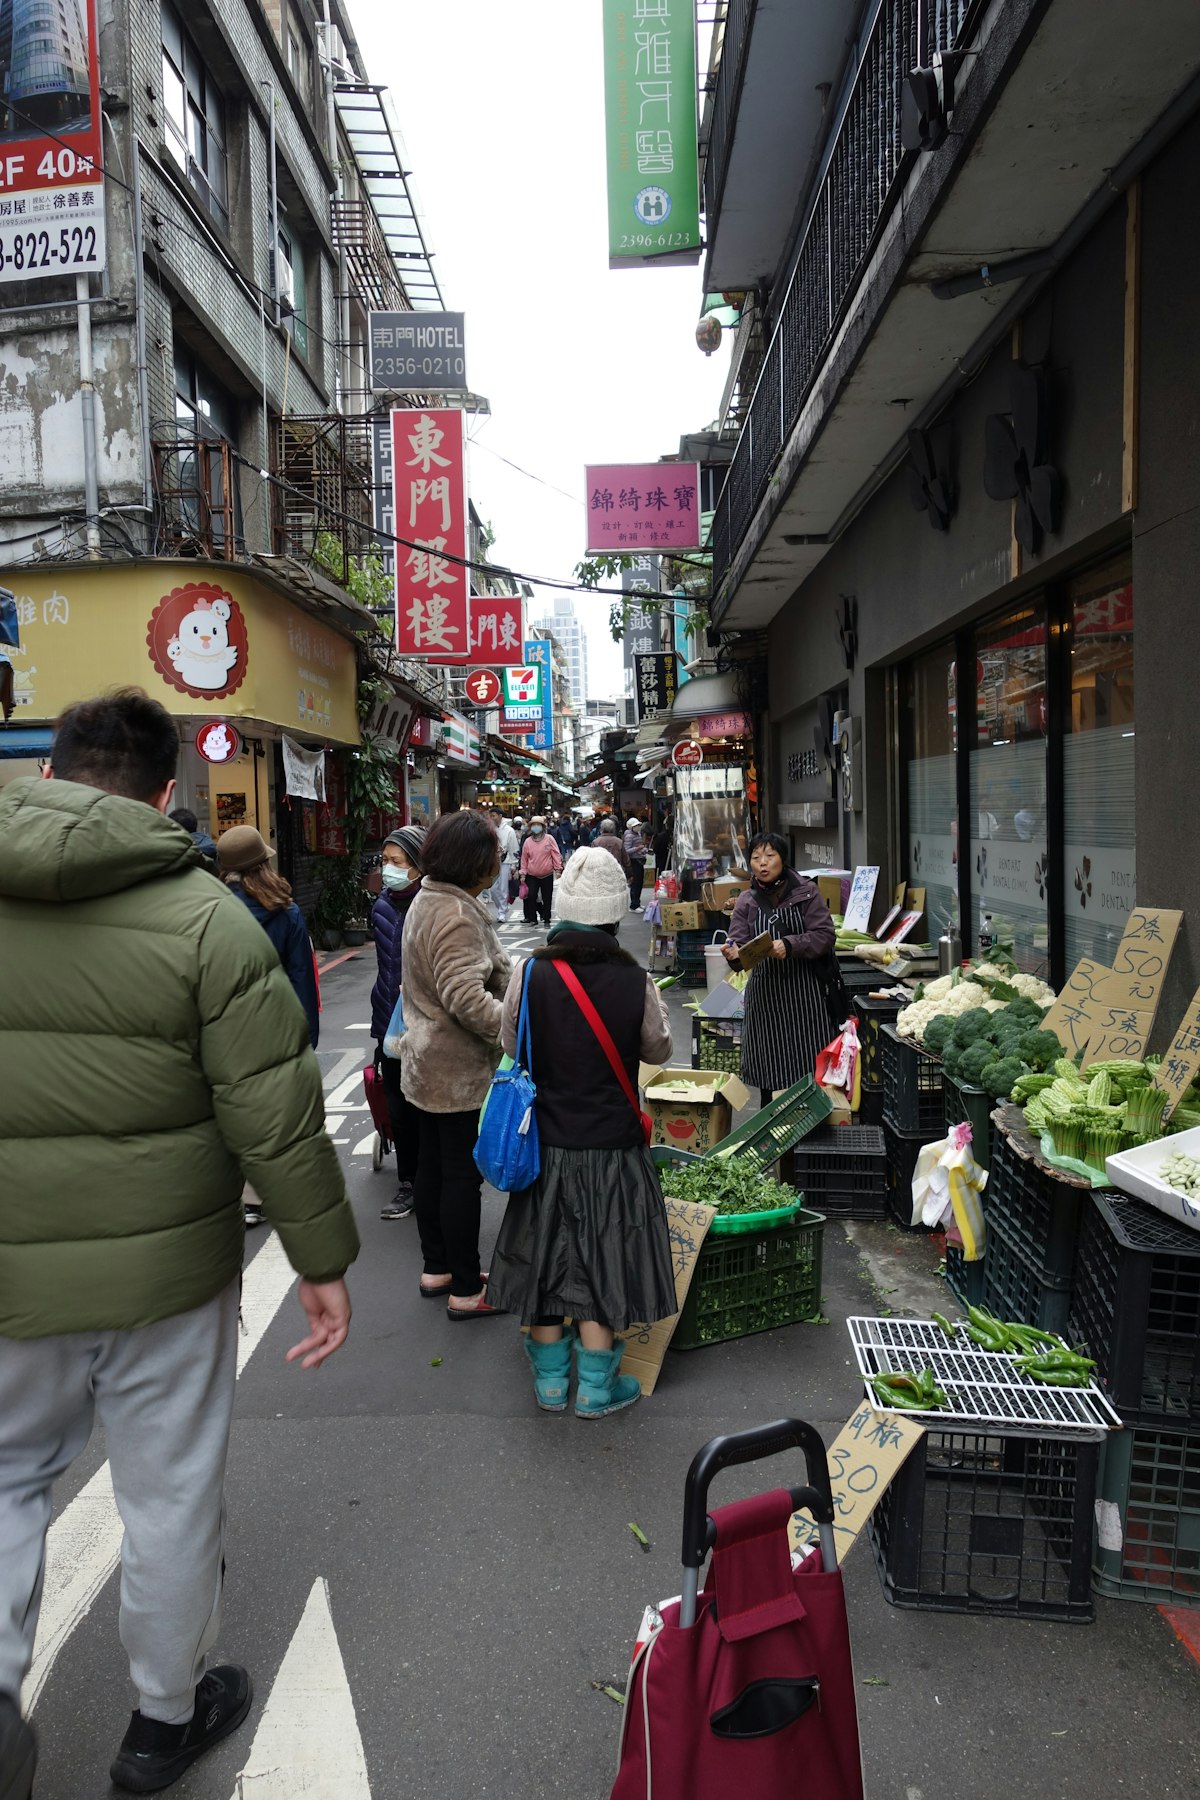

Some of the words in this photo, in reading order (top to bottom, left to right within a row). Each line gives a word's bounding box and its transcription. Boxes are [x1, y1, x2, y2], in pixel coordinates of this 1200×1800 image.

[37, 149, 94, 181] 40坪
[53, 191, 94, 209] 徐善泰
[0, 218, 41, 226] 1995.com.tw
[619, 233, 690, 248] 2396-6123
[374, 357, 464, 376] 2356-0210
[591, 485, 696, 513] 錦綺珠寶
[405, 414, 459, 652] 東門銀樓
[472, 674, 493, 700] 吉
[1111, 870, 1131, 888] DENT
[1101, 892, 1130, 912] DENTAL
[1114, 948, 1163, 978] 50
[1129, 981, 1155, 999] 元
[1093, 1034, 1142, 1056] 100
[830, 1449, 878, 1494] 30
